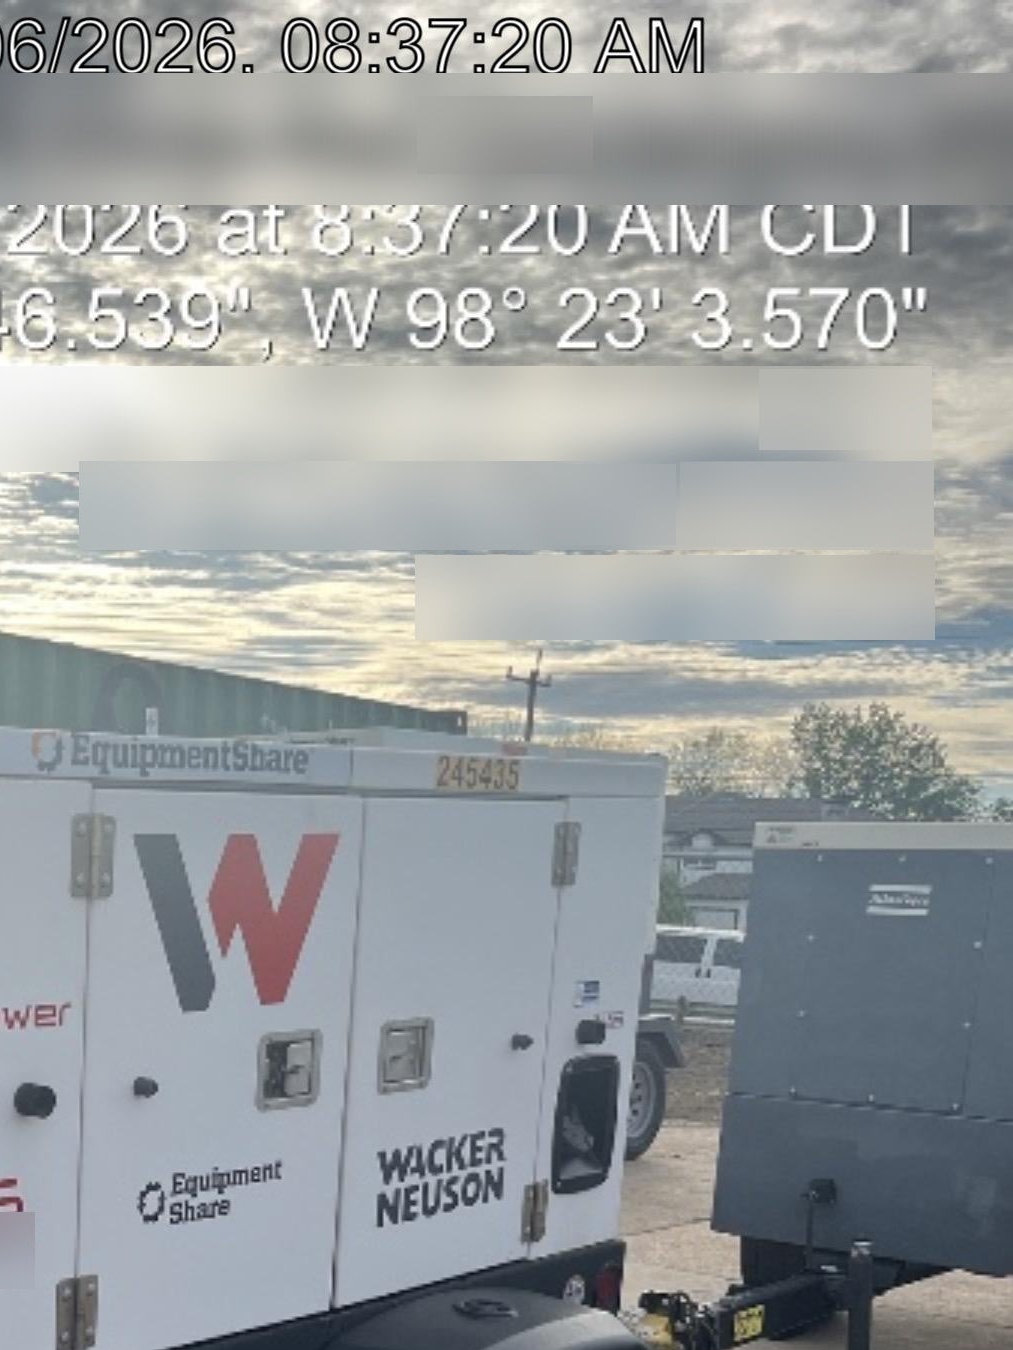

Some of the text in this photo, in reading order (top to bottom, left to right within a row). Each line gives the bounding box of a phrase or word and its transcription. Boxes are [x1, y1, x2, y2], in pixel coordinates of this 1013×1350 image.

[70, 733, 310, 777] EquipmentShare
[436, 756, 520, 790] 245435
[377, 1127, 507, 1186] WACKER
[171, 1160, 282, 1198] Equipment
[377, 1166, 505, 1228] NEUSON
[169, 1199, 231, 1225] Share
